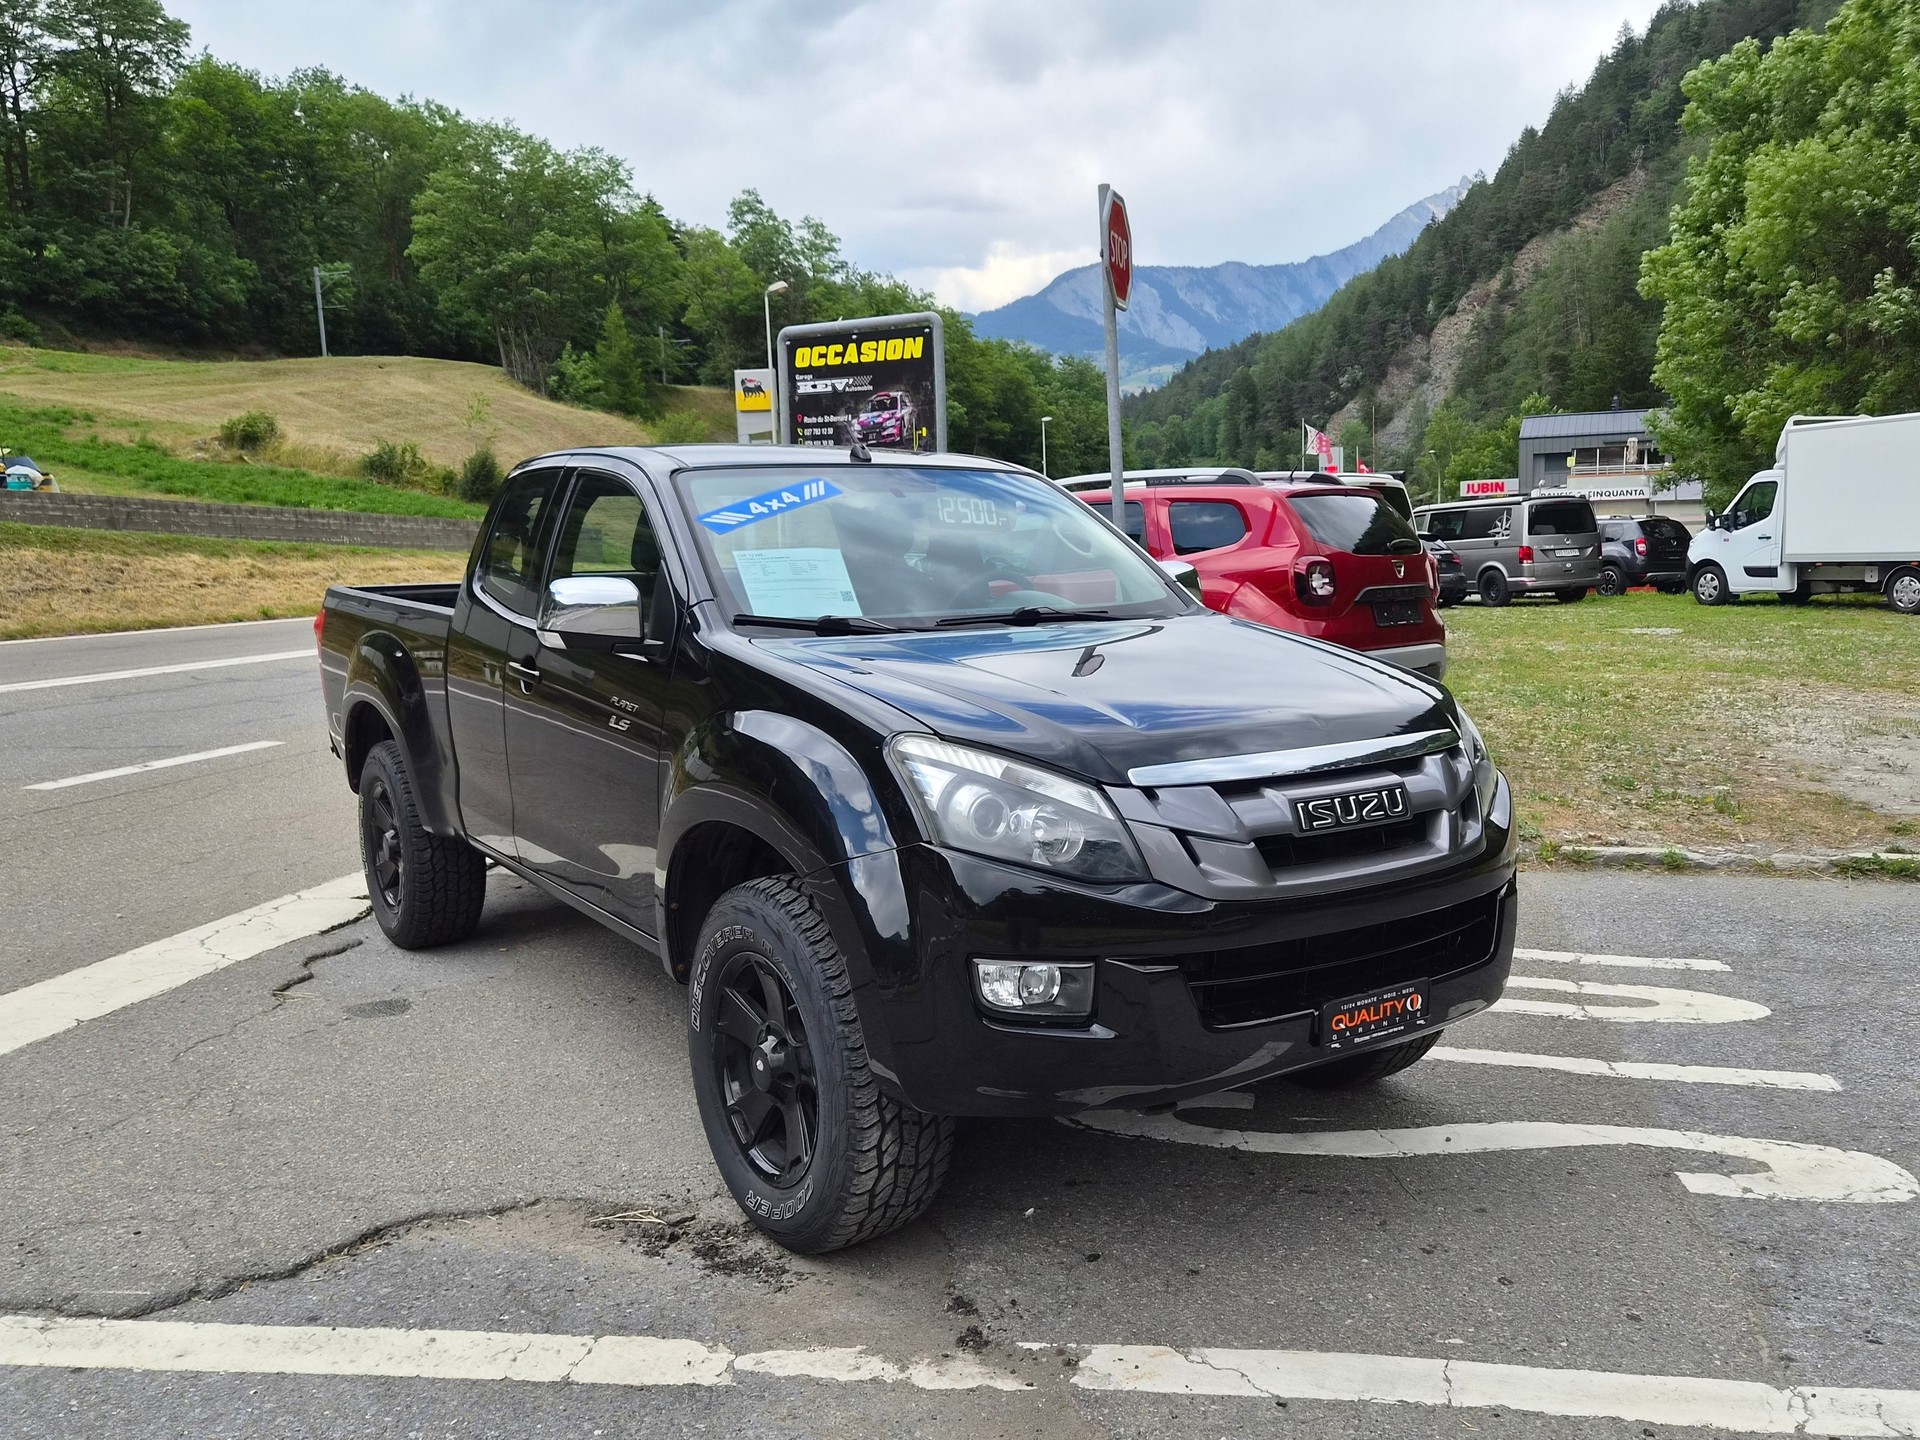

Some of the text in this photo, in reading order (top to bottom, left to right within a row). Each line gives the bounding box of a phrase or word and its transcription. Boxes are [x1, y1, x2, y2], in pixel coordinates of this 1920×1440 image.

[1110, 230, 1127, 270] STOP
[795, 337, 923, 368] OCCASION
[749, 491, 801, 514] 4x4
[1466, 482, 1505, 494] JUBIN
[1588, 489, 1645, 498] CINQUANTA
[610, 695, 639, 712] PLANET
[609, 715, 631, 731] LS
[1297, 789, 1406, 830] ISUZU
[692, 925, 754, 1032] DISCOVERER
[1357, 996, 1377, 1007] MONATE
[1402, 987, 1415, 995] MESI
[1331, 998, 1406, 1031] QUALITY
[1333, 1011, 1421, 1040] GARANTIE
[745, 1175, 814, 1220] COOPER
